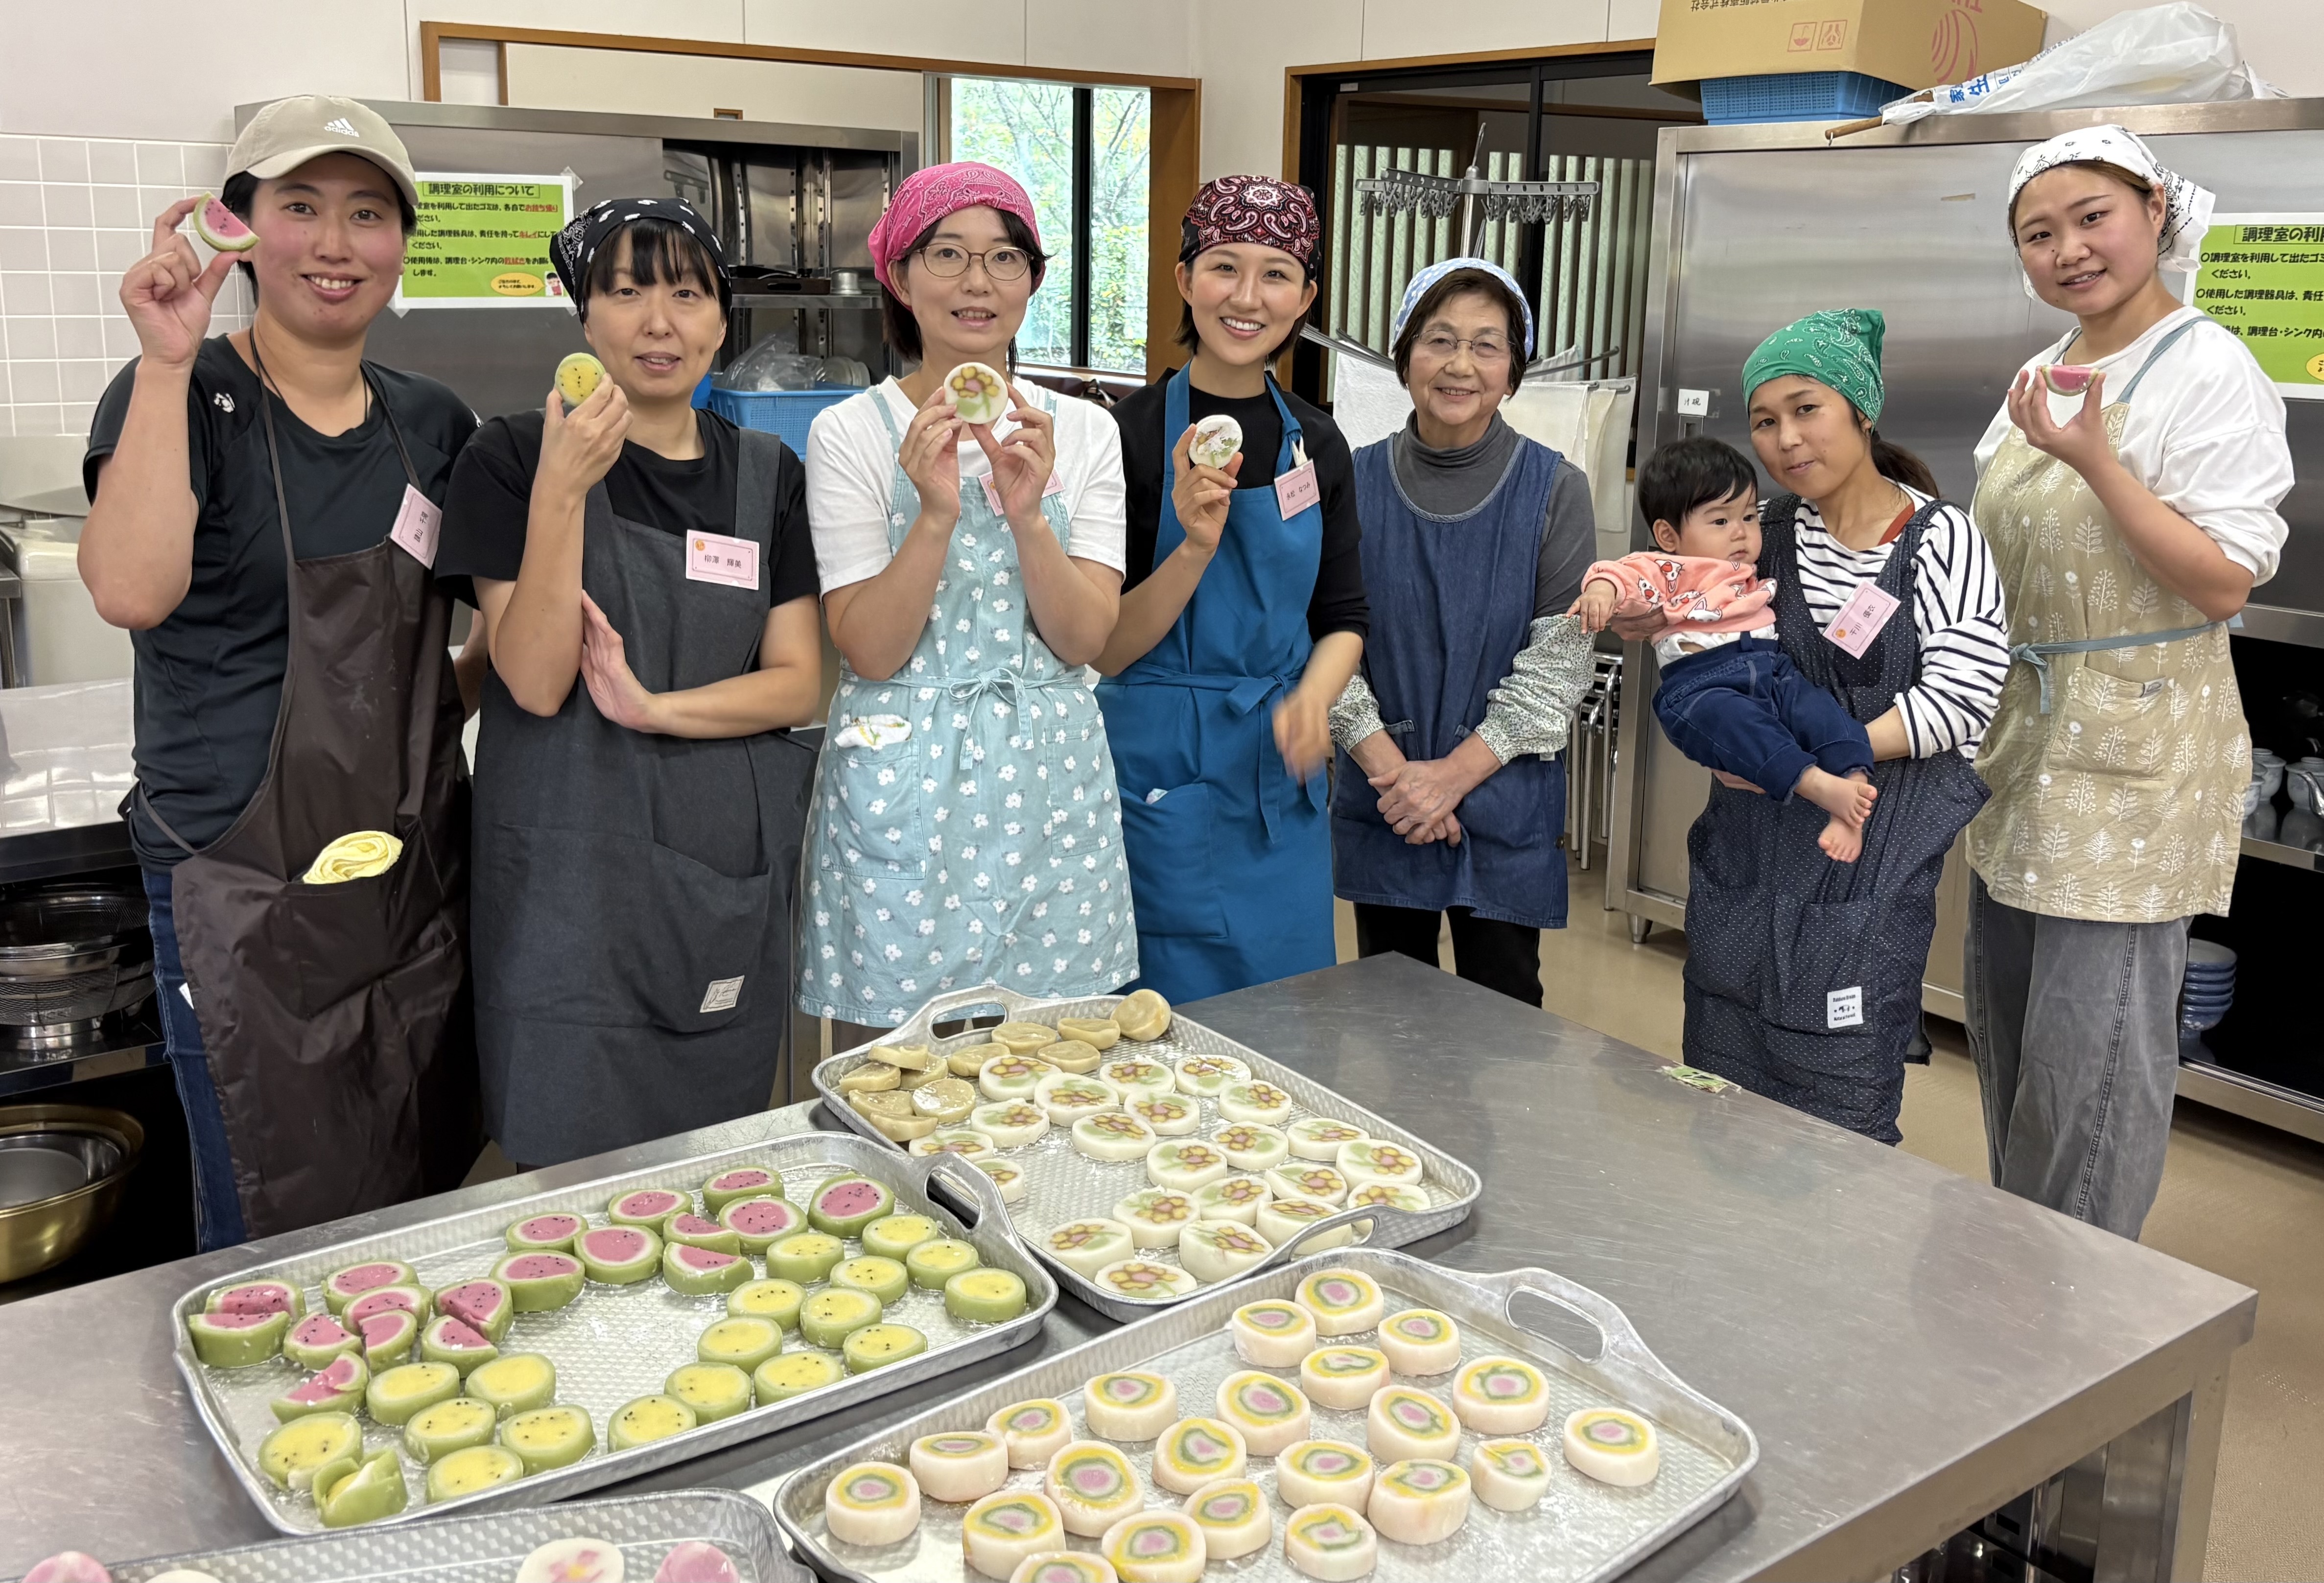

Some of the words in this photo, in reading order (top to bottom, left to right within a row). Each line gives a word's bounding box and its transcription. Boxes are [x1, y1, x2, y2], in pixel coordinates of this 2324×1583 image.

[324, 126, 360, 138] adidas
[428, 183, 535, 196] 調理室の利用について
[2211, 269, 2251, 279] ください。
[2207, 305, 2246, 316] ください。
